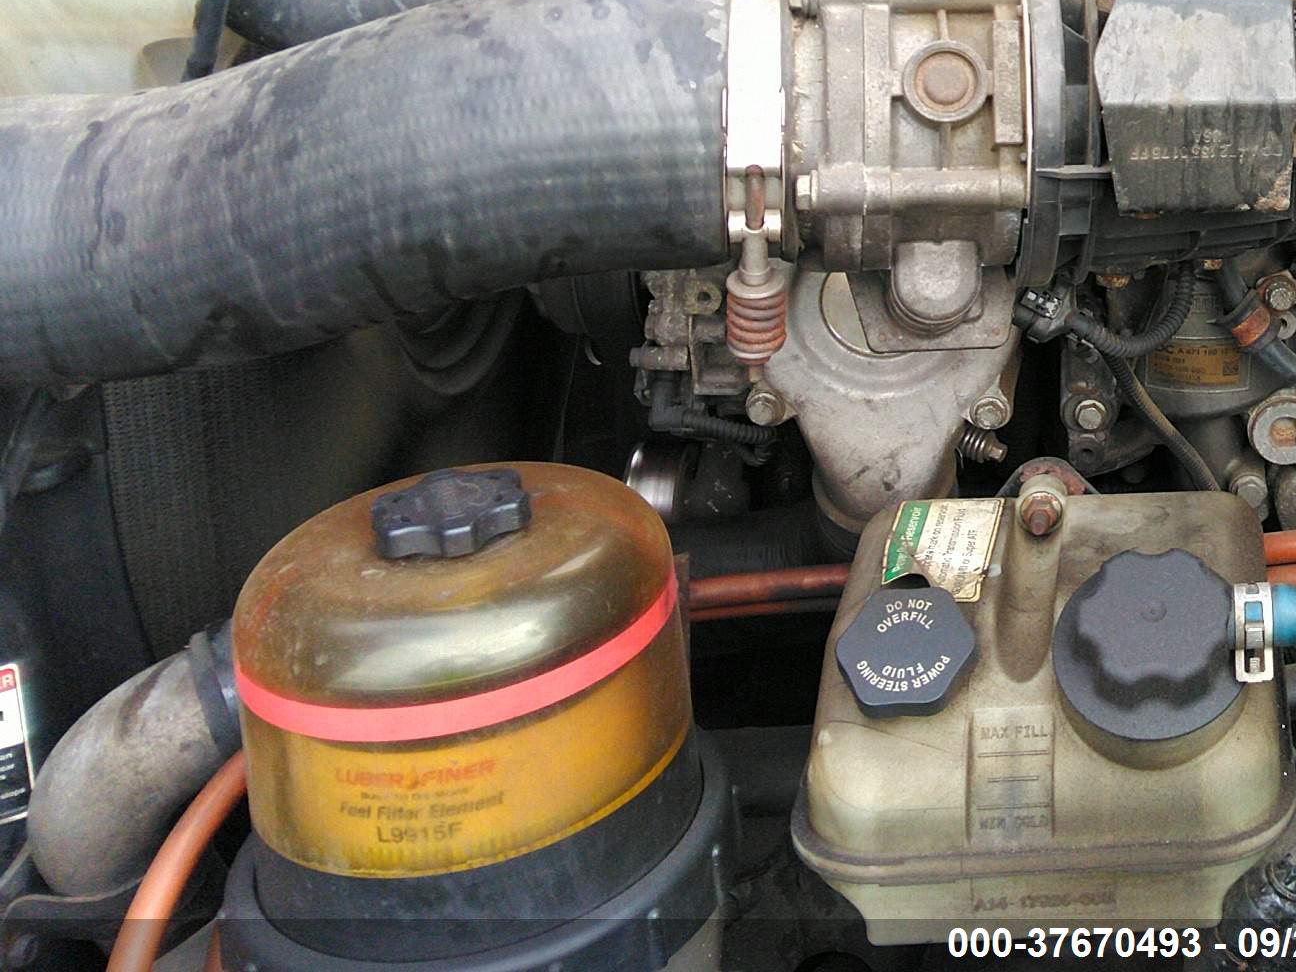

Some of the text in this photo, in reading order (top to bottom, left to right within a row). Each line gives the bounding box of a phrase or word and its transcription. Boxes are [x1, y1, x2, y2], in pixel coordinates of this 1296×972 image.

[966, 528, 978, 541] ATF
[886, 598, 933, 614] DO NOT
[876, 611, 935, 633] OVERFILL
[856, 655, 951, 692] POWER STEERING
[881, 662, 925, 679] FLUID
[980, 724, 1049, 740] MAX FILL
[420, 758, 498, 786] FINER
[340, 791, 504, 821] Fuel Filter Element
